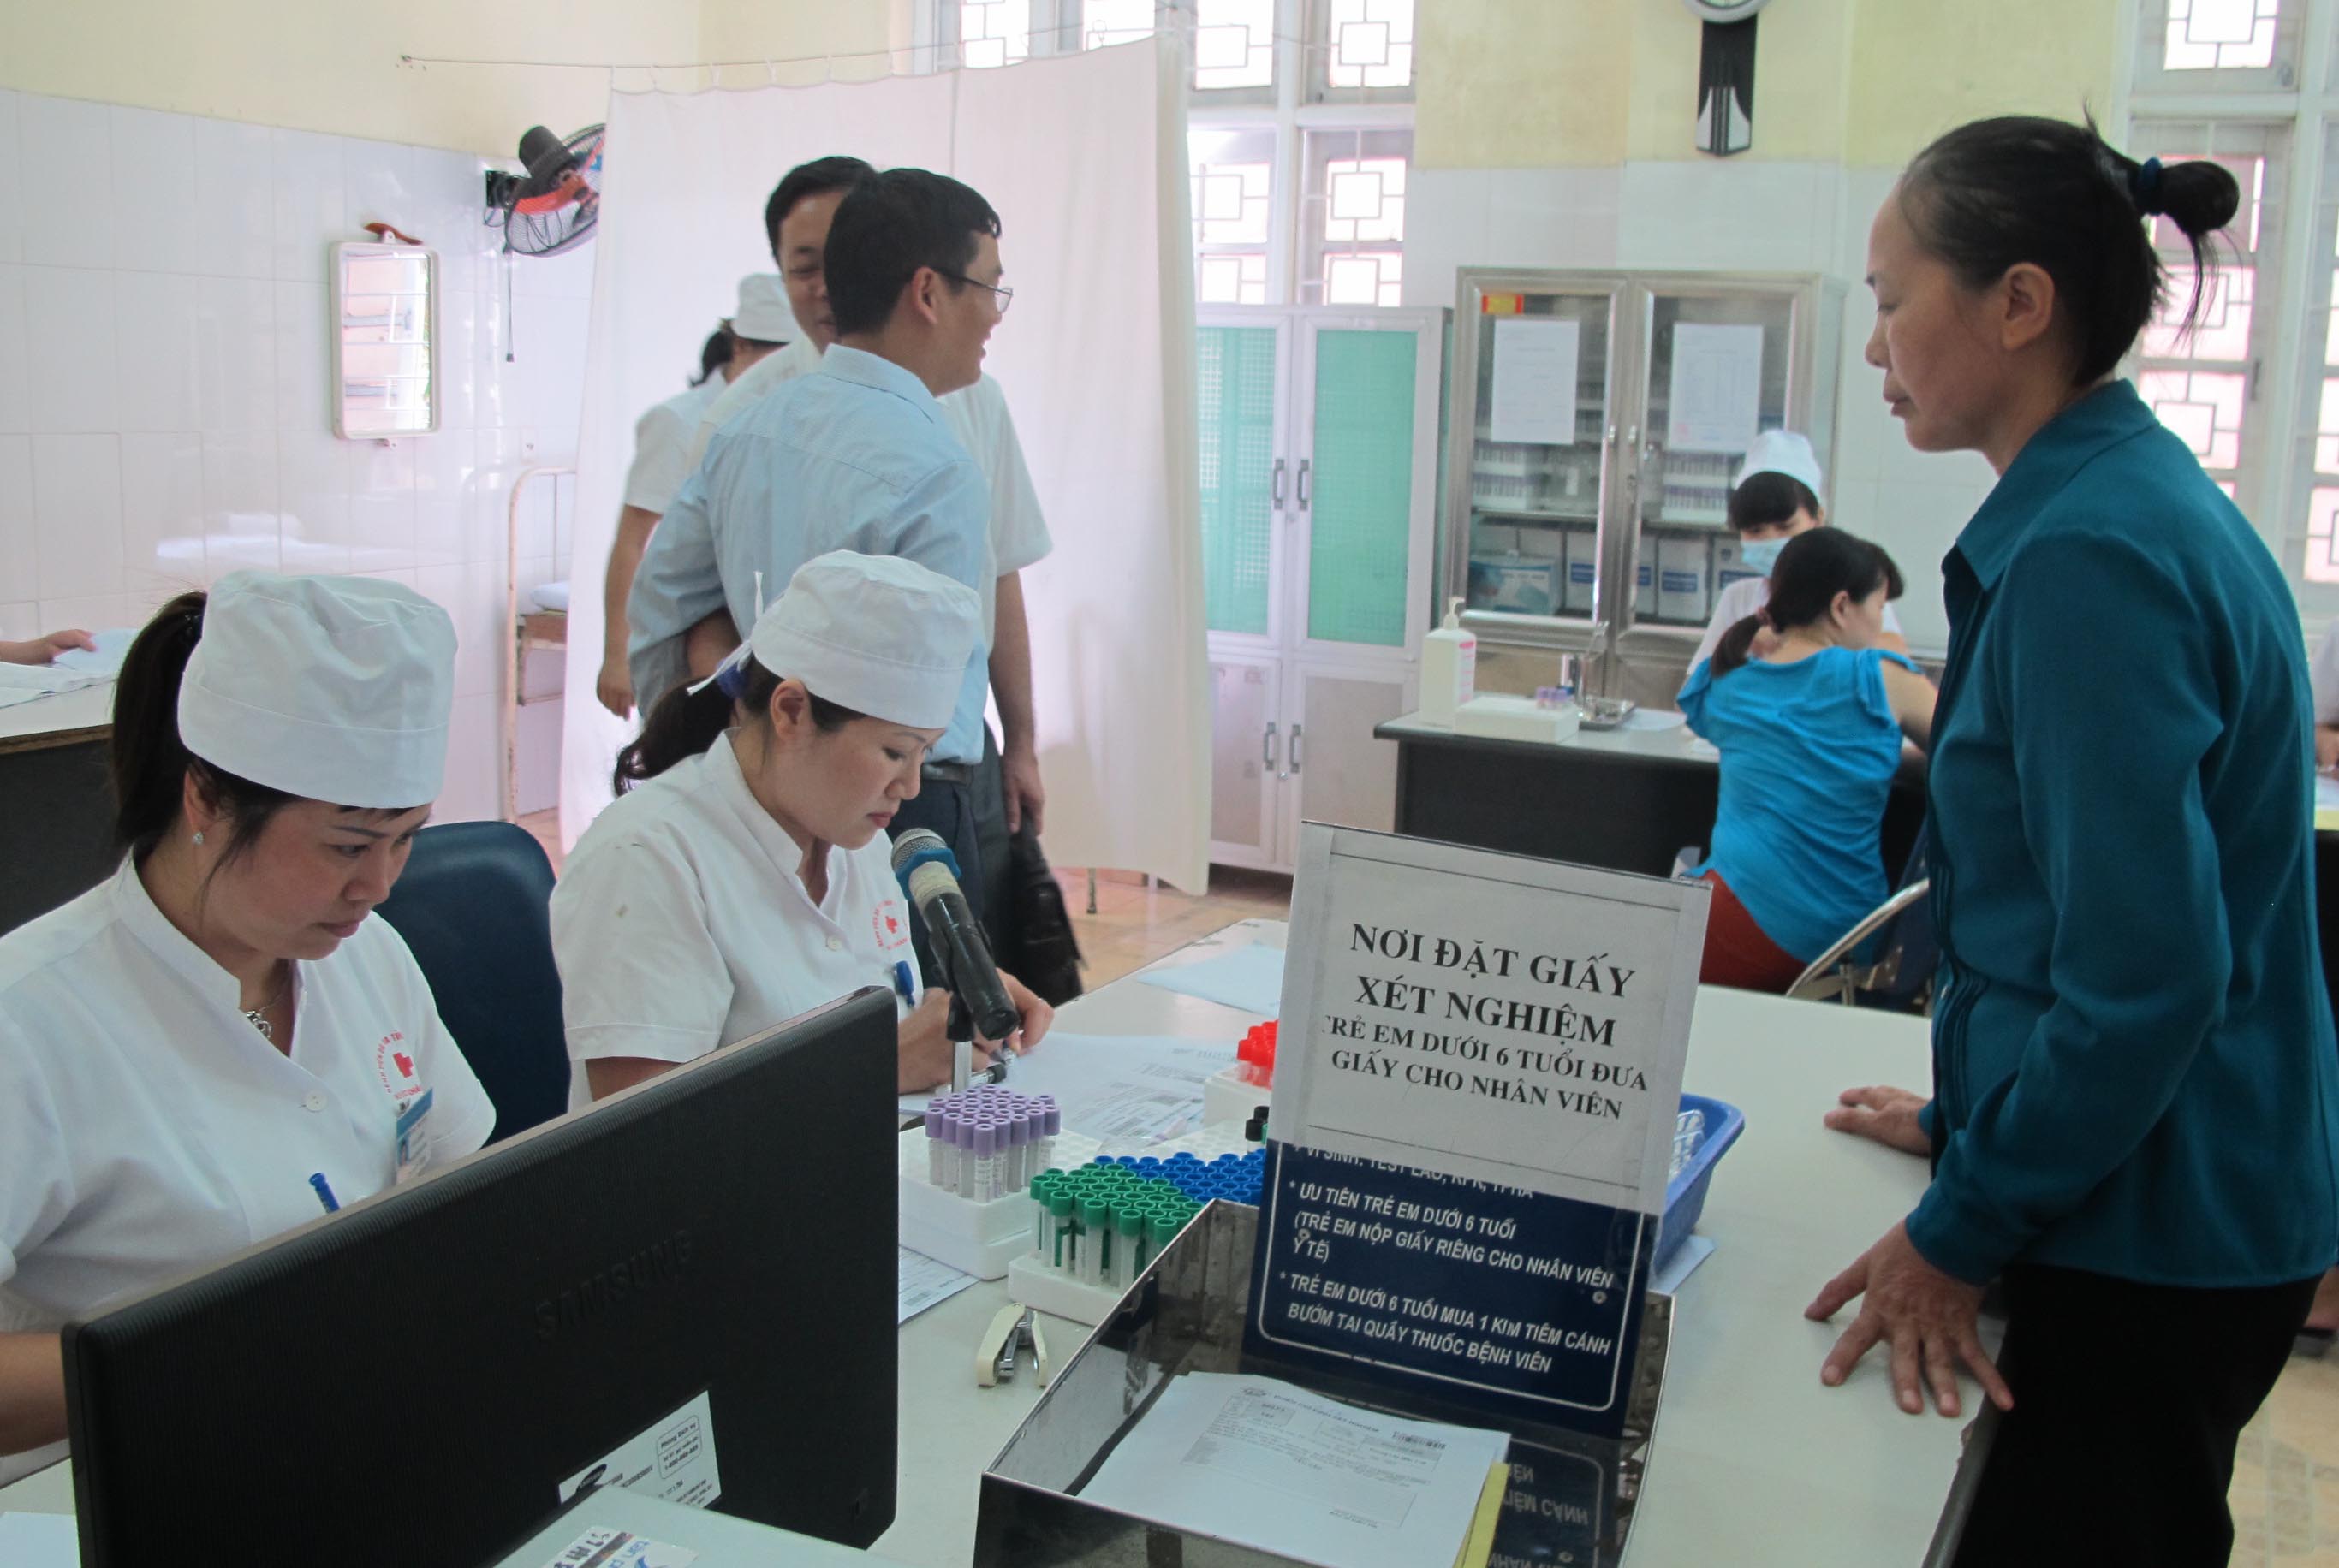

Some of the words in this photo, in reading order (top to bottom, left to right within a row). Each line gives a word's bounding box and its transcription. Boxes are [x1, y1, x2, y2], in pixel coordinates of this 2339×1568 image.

[1350, 924, 1425, 962] NƠI
[1433, 937, 1519, 979] ĐẶT
[1530, 953, 1635, 997] GIẤY
[1354, 974, 1435, 1014] XÉT
[1445, 991, 1616, 1048] NGHIỆM
[1332, 1049, 1398, 1078] GIẤY
[1406, 1063, 1463, 1091] CHO
[1471, 1075, 1549, 1107] NHÂN
[1557, 1090, 1623, 1120] VIÊN
[1373, 1025, 1414, 1048] EM
[1421, 1032, 1491, 1062] DƯỚI
[1496, 1047, 1509, 1066] 6
[1517, 1048, 1585, 1078] TUỔI
[1592, 1062, 1647, 1091] ĐƯA
[1300, 1181, 1322, 1201] ƯU
[1325, 1186, 1360, 1209] TIÊN
[1396, 1202, 1419, 1221] EM
[1423, 1206, 1464, 1229] DƯỚI
[1465, 1215, 1474, 1232] 6
[1294, 1210, 1331, 1232] (TRẺ
[1333, 1218, 1356, 1237] EM
[1359, 1222, 1392, 1246] NỘP
[1396, 1229, 1435, 1253] GIẤY
[1435, 1238, 1485, 1263] RIÊNG
[1488, 1250, 1523, 1271] CHO
[1526, 1256, 1574, 1281] NHÂN
[1576, 1266, 1615, 1288] VIÊN
[1287, 1302, 1334, 1327] BƯỚM
[1410, 1329, 1465, 1356] THUỐC
[1467, 1340, 1512, 1366] BỆNH
[1290, 1274, 1321, 1294] TRẺ
[1322, 1280, 1346, 1300] EM
[1347, 1286, 1388, 1310] DƯỚI
[1389, 1296, 1398, 1312] 6
[1439, 1305, 1474, 1328] MUA
[1479, 1315, 1489, 1331] 1
[1491, 1317, 1523, 1338] KIM
[1525, 1322, 1564, 1346] TIÊM
[1565, 1331, 1612, 1356] CÁNH
